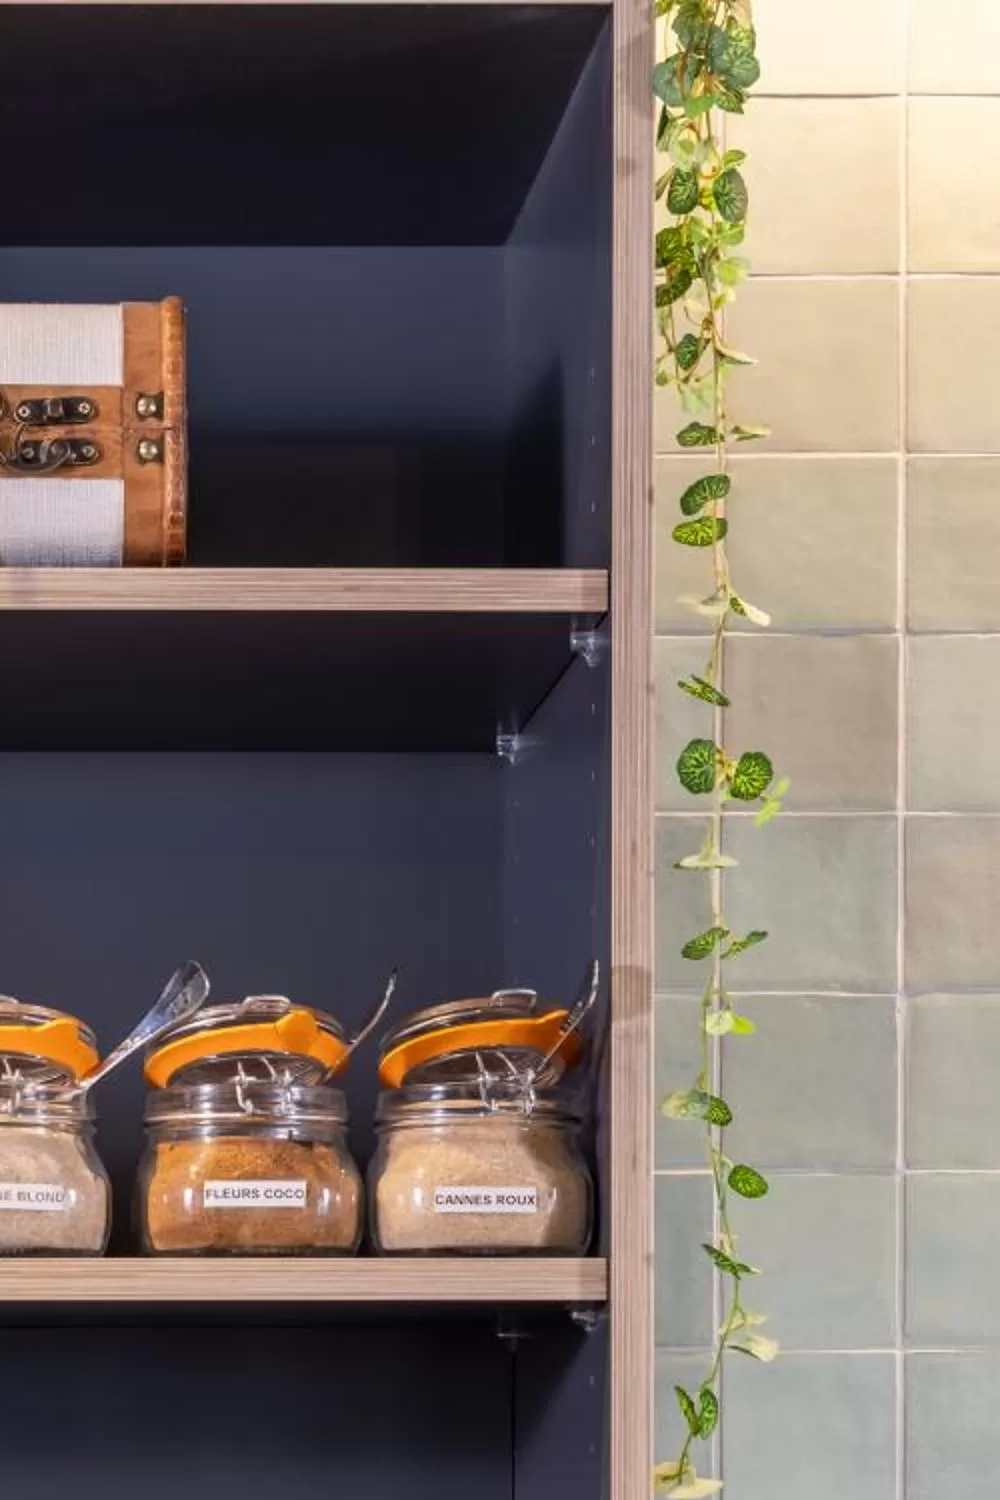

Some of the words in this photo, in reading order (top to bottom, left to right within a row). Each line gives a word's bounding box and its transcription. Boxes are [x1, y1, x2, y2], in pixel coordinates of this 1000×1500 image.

[205, 1187, 260, 1199] FLEURS
[263, 1187, 305, 1199] COCO
[435, 1195, 492, 1205] CANNES
[495, 1195, 535, 1205] ROUX
